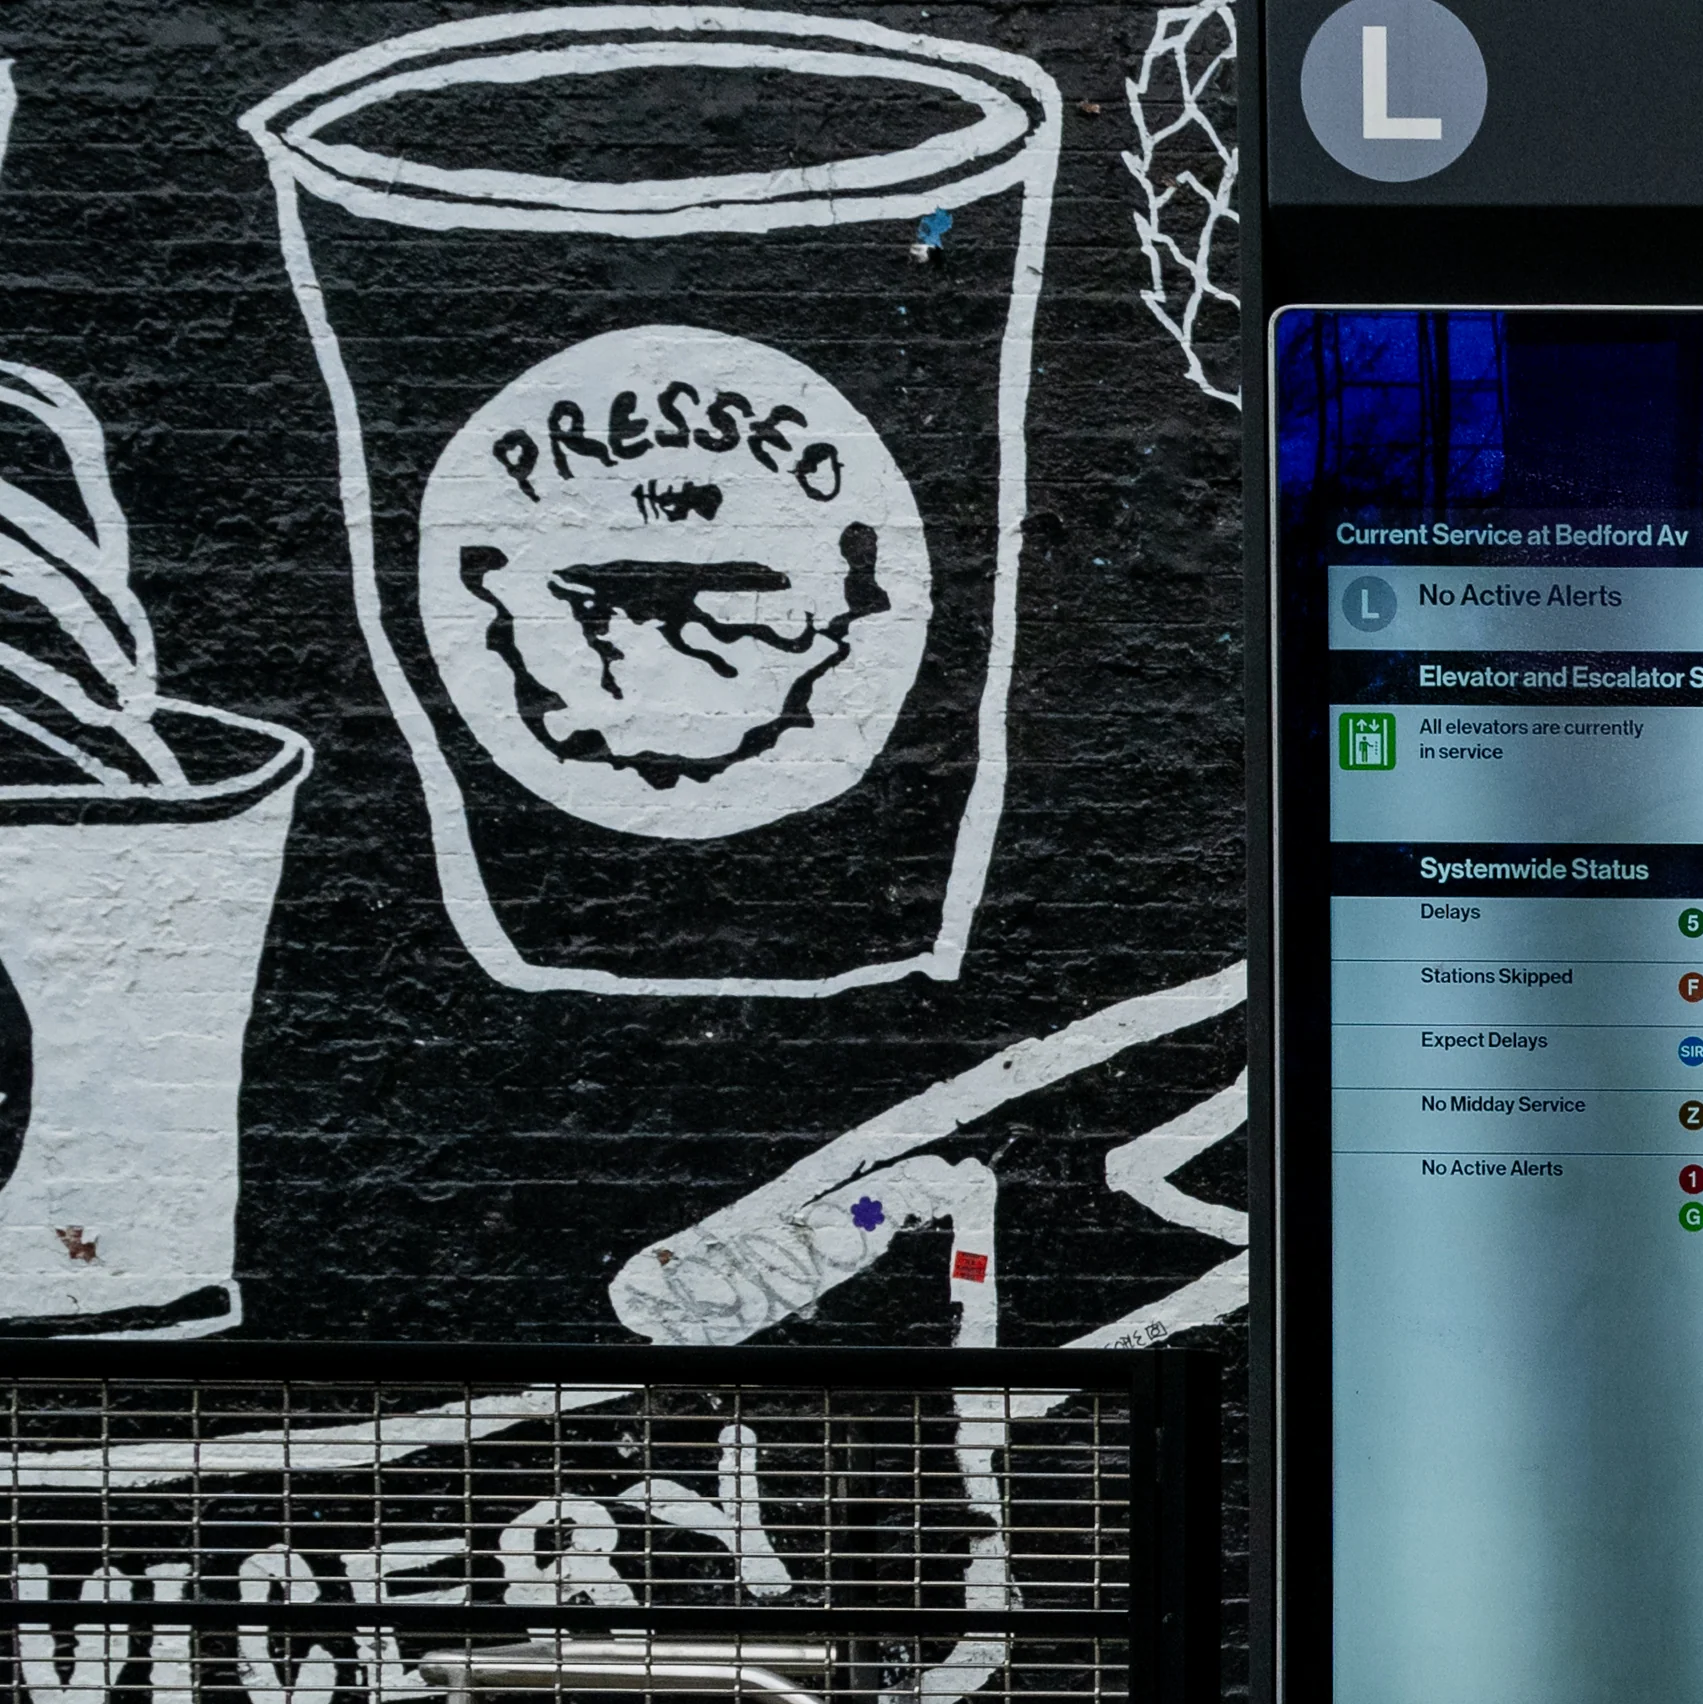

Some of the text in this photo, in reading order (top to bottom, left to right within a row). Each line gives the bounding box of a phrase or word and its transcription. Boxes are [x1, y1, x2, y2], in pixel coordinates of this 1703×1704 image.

[1362, 26, 1442, 140] L
[1336, 522, 1689, 545] Current Service at Bedford Av
[1362, 589, 1380, 619] L
[1419, 584, 1622, 606] No Active Alerts
[1419, 666, 1518, 687] Elevator
[1523, 666, 1567, 687] and
[1573, 666, 1685, 688] Escalator
[1420, 719, 1644, 738] All elevators are currently
[1420, 745, 1504, 760] in service
[1420, 857, 1649, 883] Systemwide Status
[1421, 903, 1481, 922] Delays
[1688, 915, 1698, 931] 5
[1421, 967, 1573, 988] Stations Skipped
[1688, 979, 1699, 995] F
[1421, 1032, 1548, 1051] Expect Delays
[1680, 1045, 1703, 1058] SIR
[1422, 1096, 1586, 1116] No Midday Service
[1687, 1107, 1699, 1124] Z
[1422, 1160, 1563, 1176] No Active Alerts
[1688, 1171, 1697, 1187] 1
[1686, 1208, 1700, 1225] G
